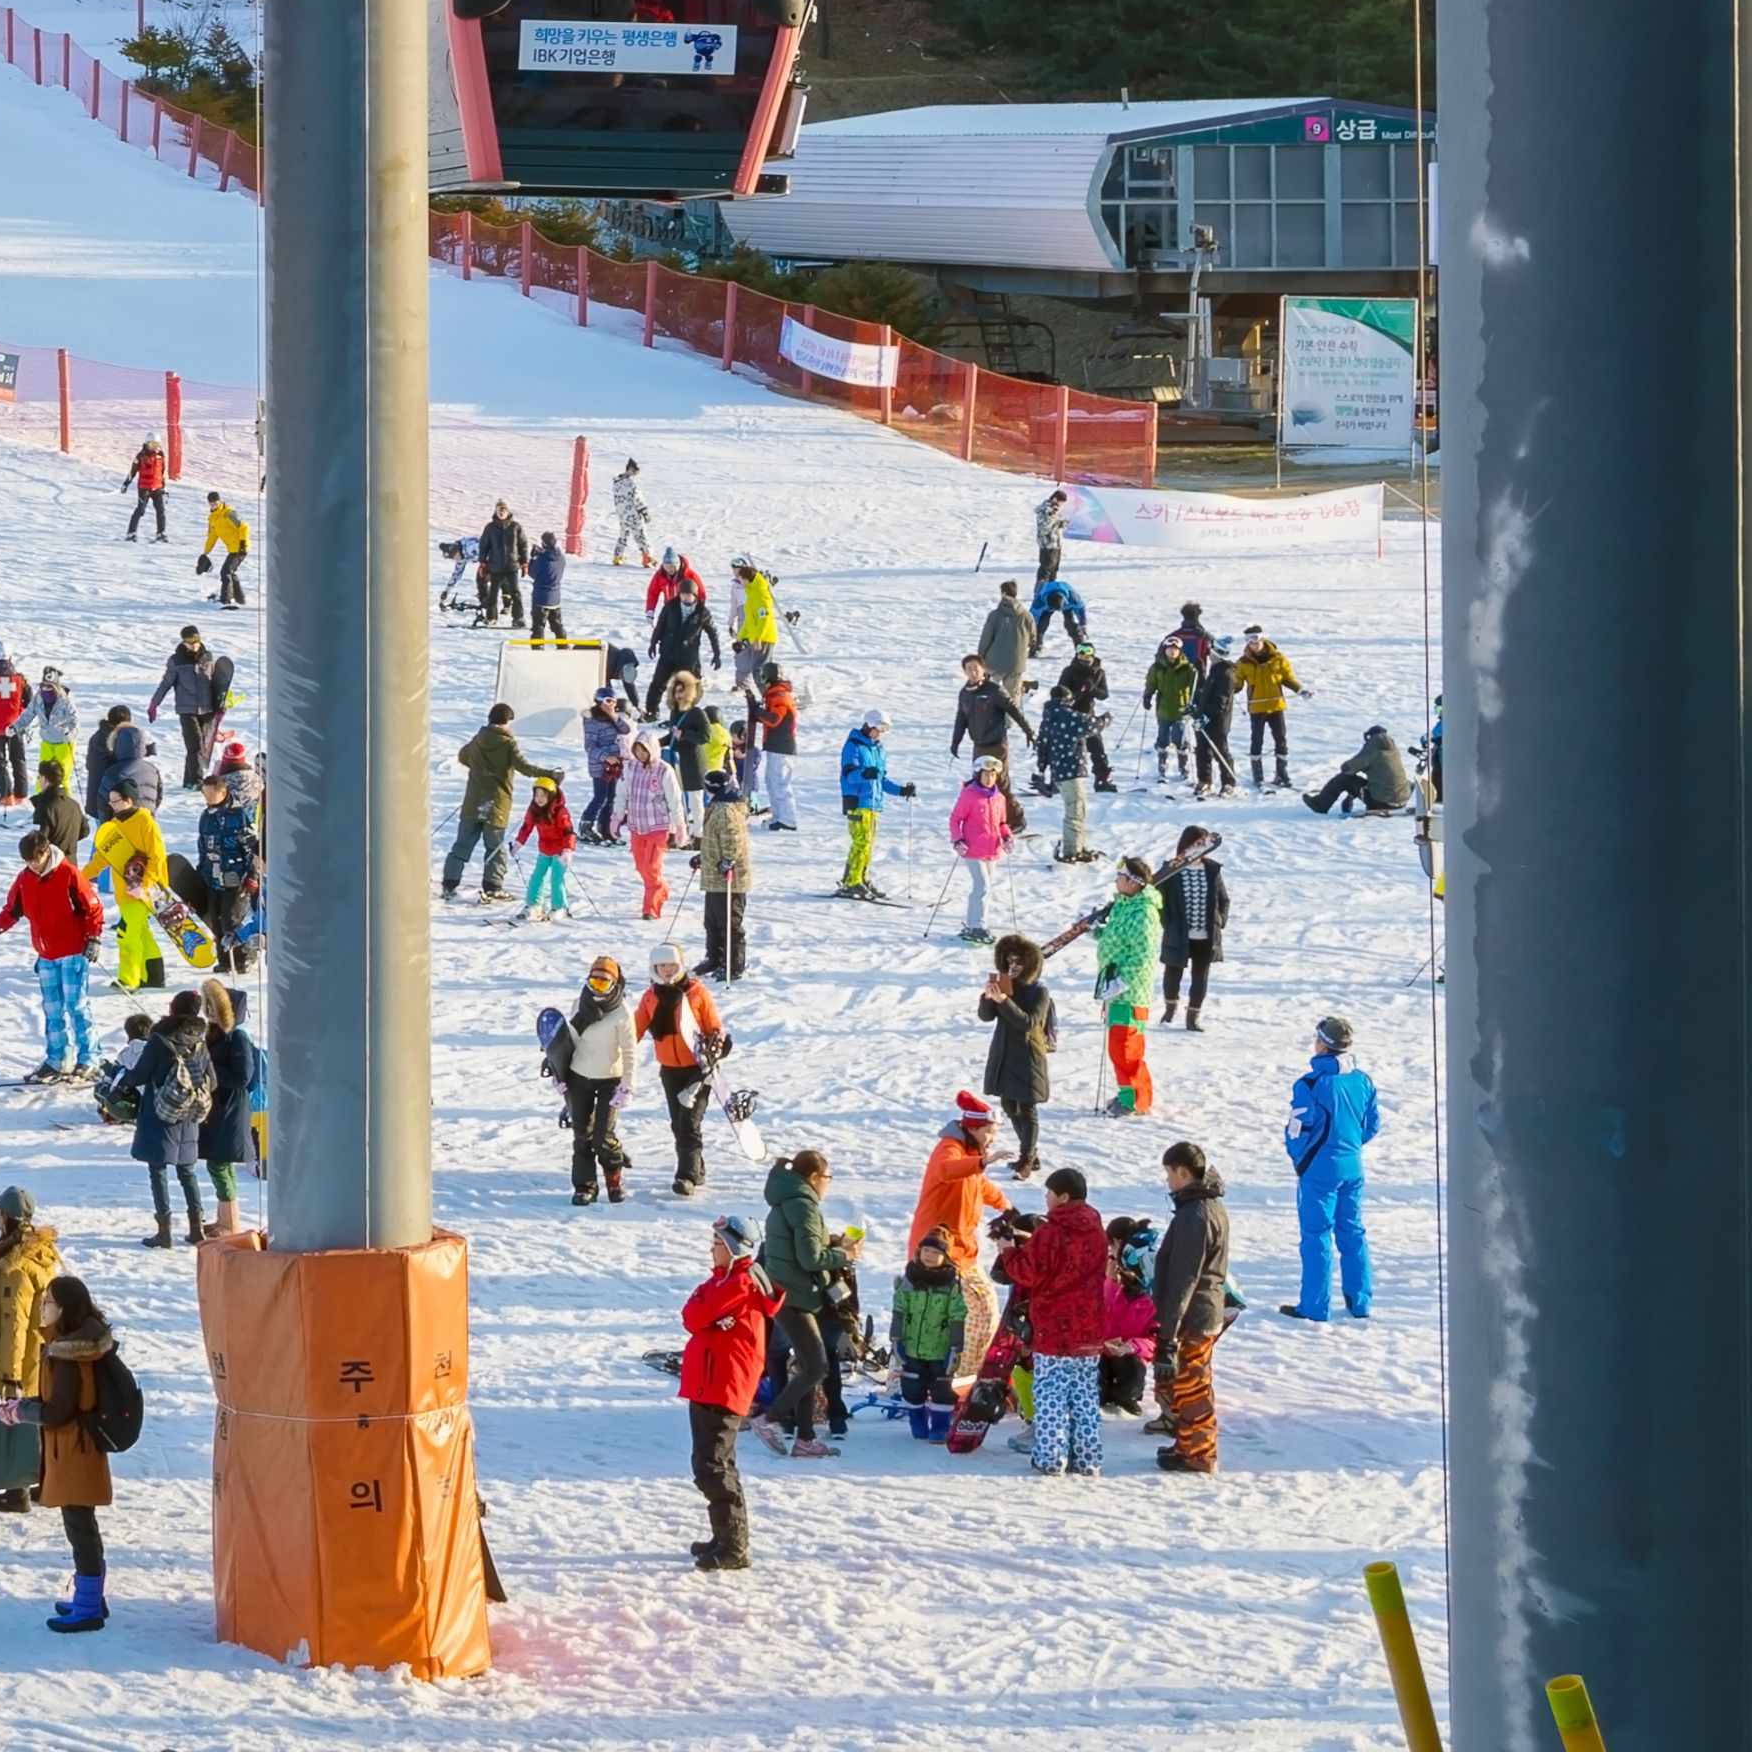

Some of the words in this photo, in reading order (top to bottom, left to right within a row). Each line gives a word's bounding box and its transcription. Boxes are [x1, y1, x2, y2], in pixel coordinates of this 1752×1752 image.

[534, 27, 575, 45] 희망을
[578, 28, 619, 46] 키우는
[621, 29, 678, 48] 평생은행
[1312, 121, 1322, 135] 9
[1336, 119, 1378, 141] 상급
[1381, 130, 1402, 140] Most
[1295, 340, 1314, 351] 기본
[1317, 340, 1337, 351] 안전
[1339, 340, 1358, 351] 수칙
[1135, 501, 1170, 523] 스키
